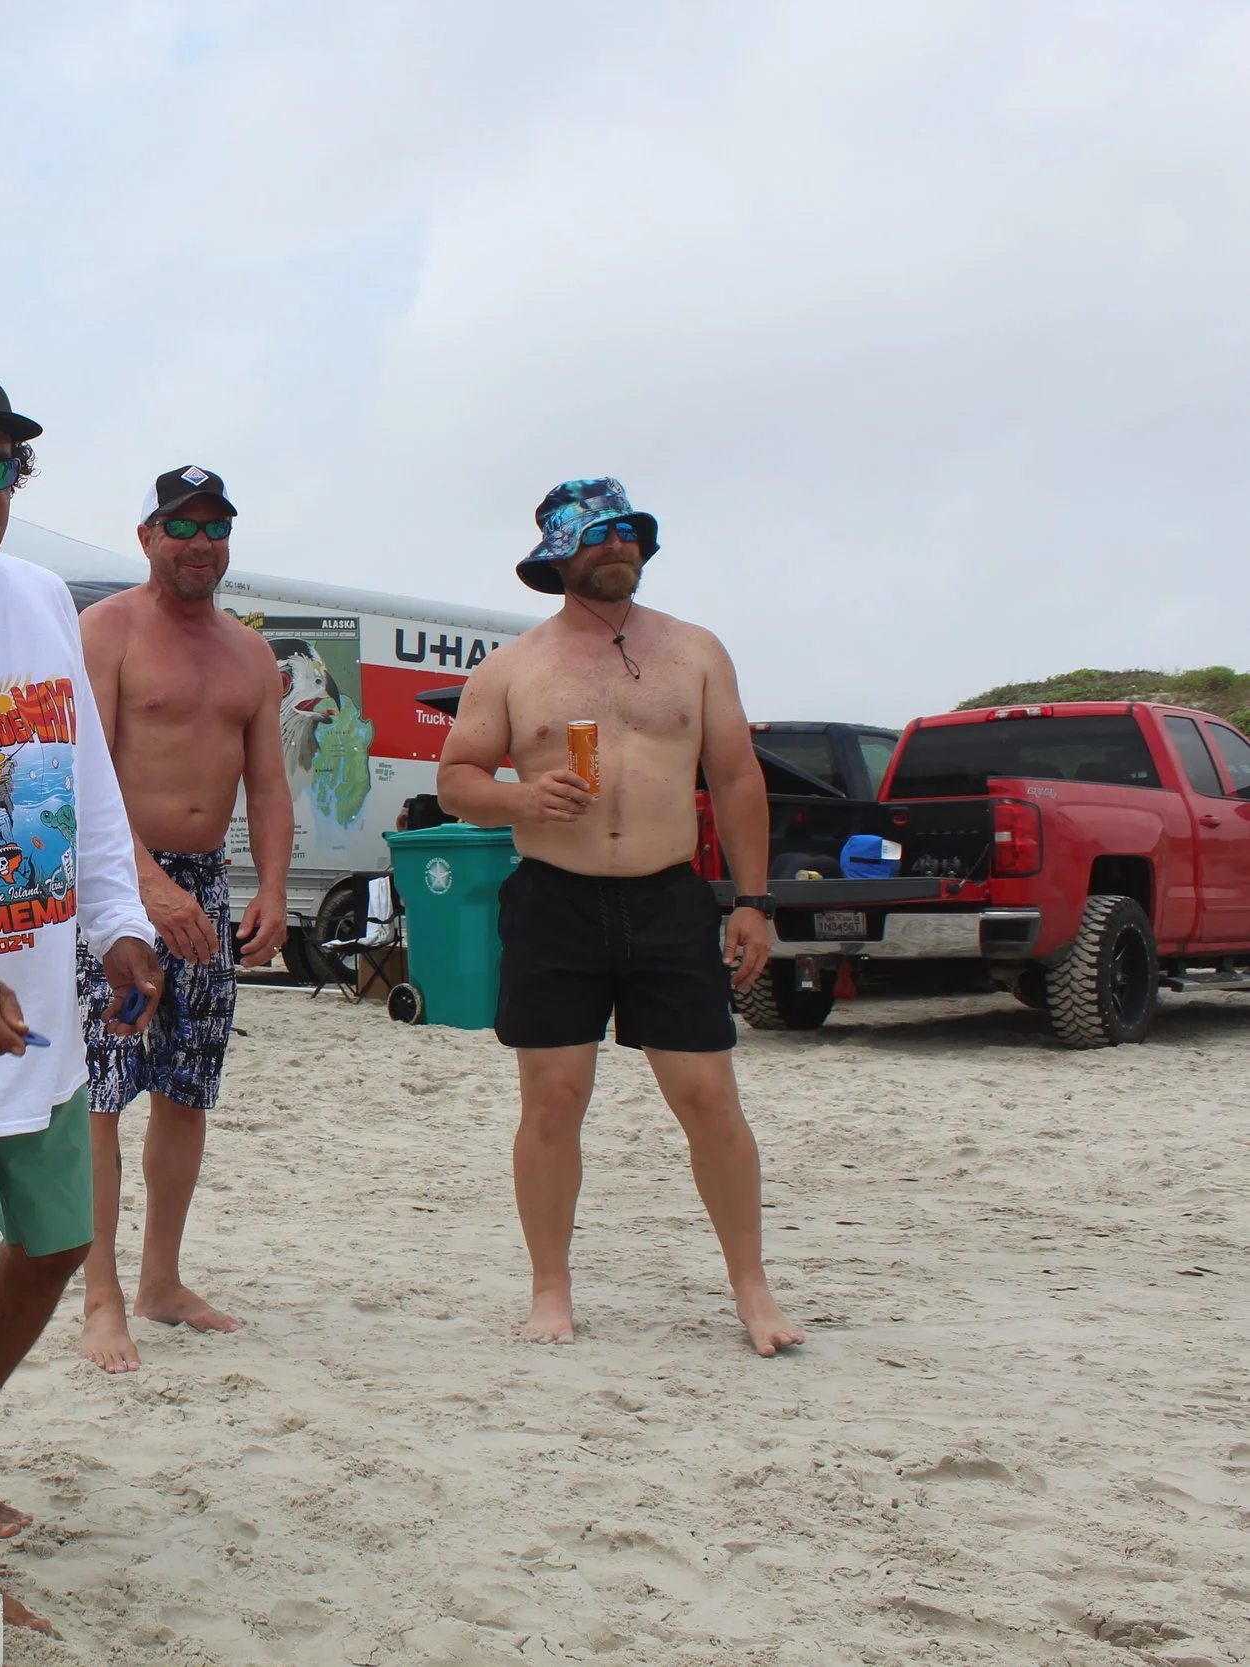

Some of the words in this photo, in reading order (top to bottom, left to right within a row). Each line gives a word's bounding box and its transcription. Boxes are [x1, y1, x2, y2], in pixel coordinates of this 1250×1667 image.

[322, 619, 356, 629] ALASKA
[395, 628, 499, 670] U-HA
[415, 709, 446, 726] Truck
